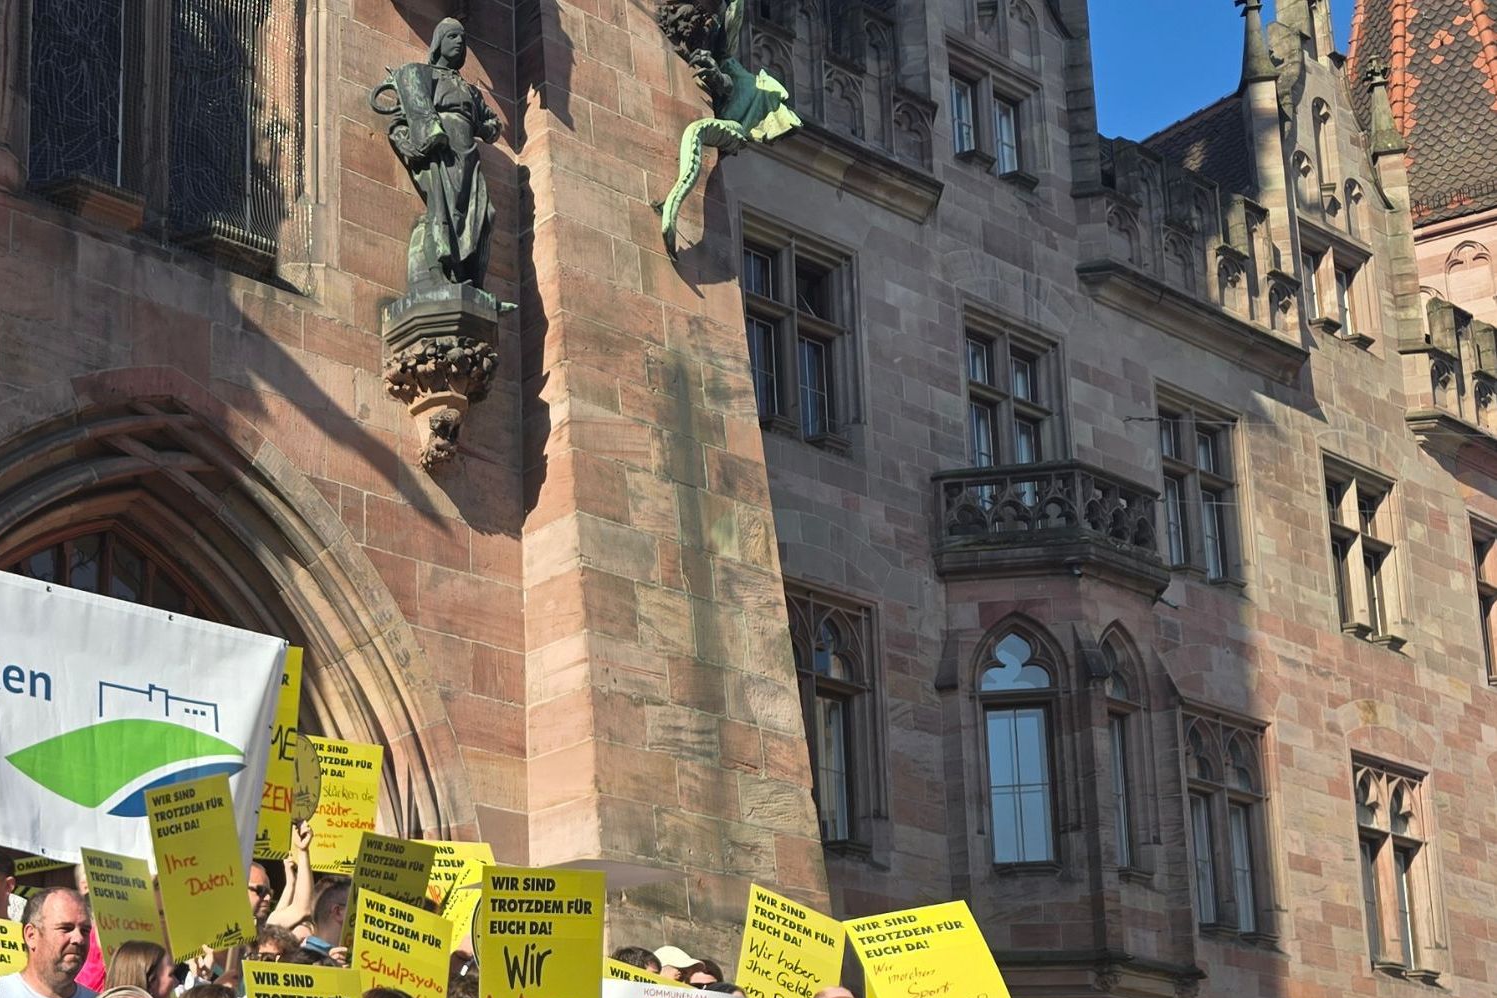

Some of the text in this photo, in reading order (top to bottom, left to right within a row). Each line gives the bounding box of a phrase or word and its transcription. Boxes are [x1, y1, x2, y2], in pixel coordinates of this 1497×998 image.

[327, 744, 349, 755] SIND
[317, 757, 373, 770] OTZDEM FÜR
[330, 769, 346, 779] DA!
[152, 788, 196, 807] WIR SIND
[154, 796, 224, 822] TROTZDEM FÜR
[157, 819, 201, 839] EUCH DA!
[367, 839, 405, 854] WIR SIND
[87, 855, 123, 871] WIR SIND
[164, 853, 199, 875] Ihre
[362, 852, 425, 873] TROTZDEM FÜR
[90, 872, 147, 890] TROTZDEM FÜR
[184, 865, 235, 897] Daten!
[359, 867, 398, 882] EUCH DA!
[491, 876, 556, 892] WIR SIND
[94, 886, 129, 901] EUCH DA!
[366, 898, 415, 923] WIR SIND
[490, 898, 592, 915] TROTZDEM FÜR
[756, 891, 807, 920] WIR SIND
[363, 914, 420, 941] TROTZDEM
[422, 933, 442, 950] FÜR
[489, 921, 553, 936] EUCH DA!
[754, 905, 835, 948] TROTZDEM FÜR
[852, 914, 918, 933] WIR SIND
[858, 920, 965, 946] TROTZDEM FÜR
[362, 929, 411, 954] EUCH DA!
[752, 919, 802, 948] EUCH DA!
[865, 940, 930, 959] EUCH DA!
[504, 943, 552, 990] Wir
[749, 937, 821, 984] Wir haben
[252, 971, 314, 988] WIR SIND
[610, 966, 632, 982] WIR
